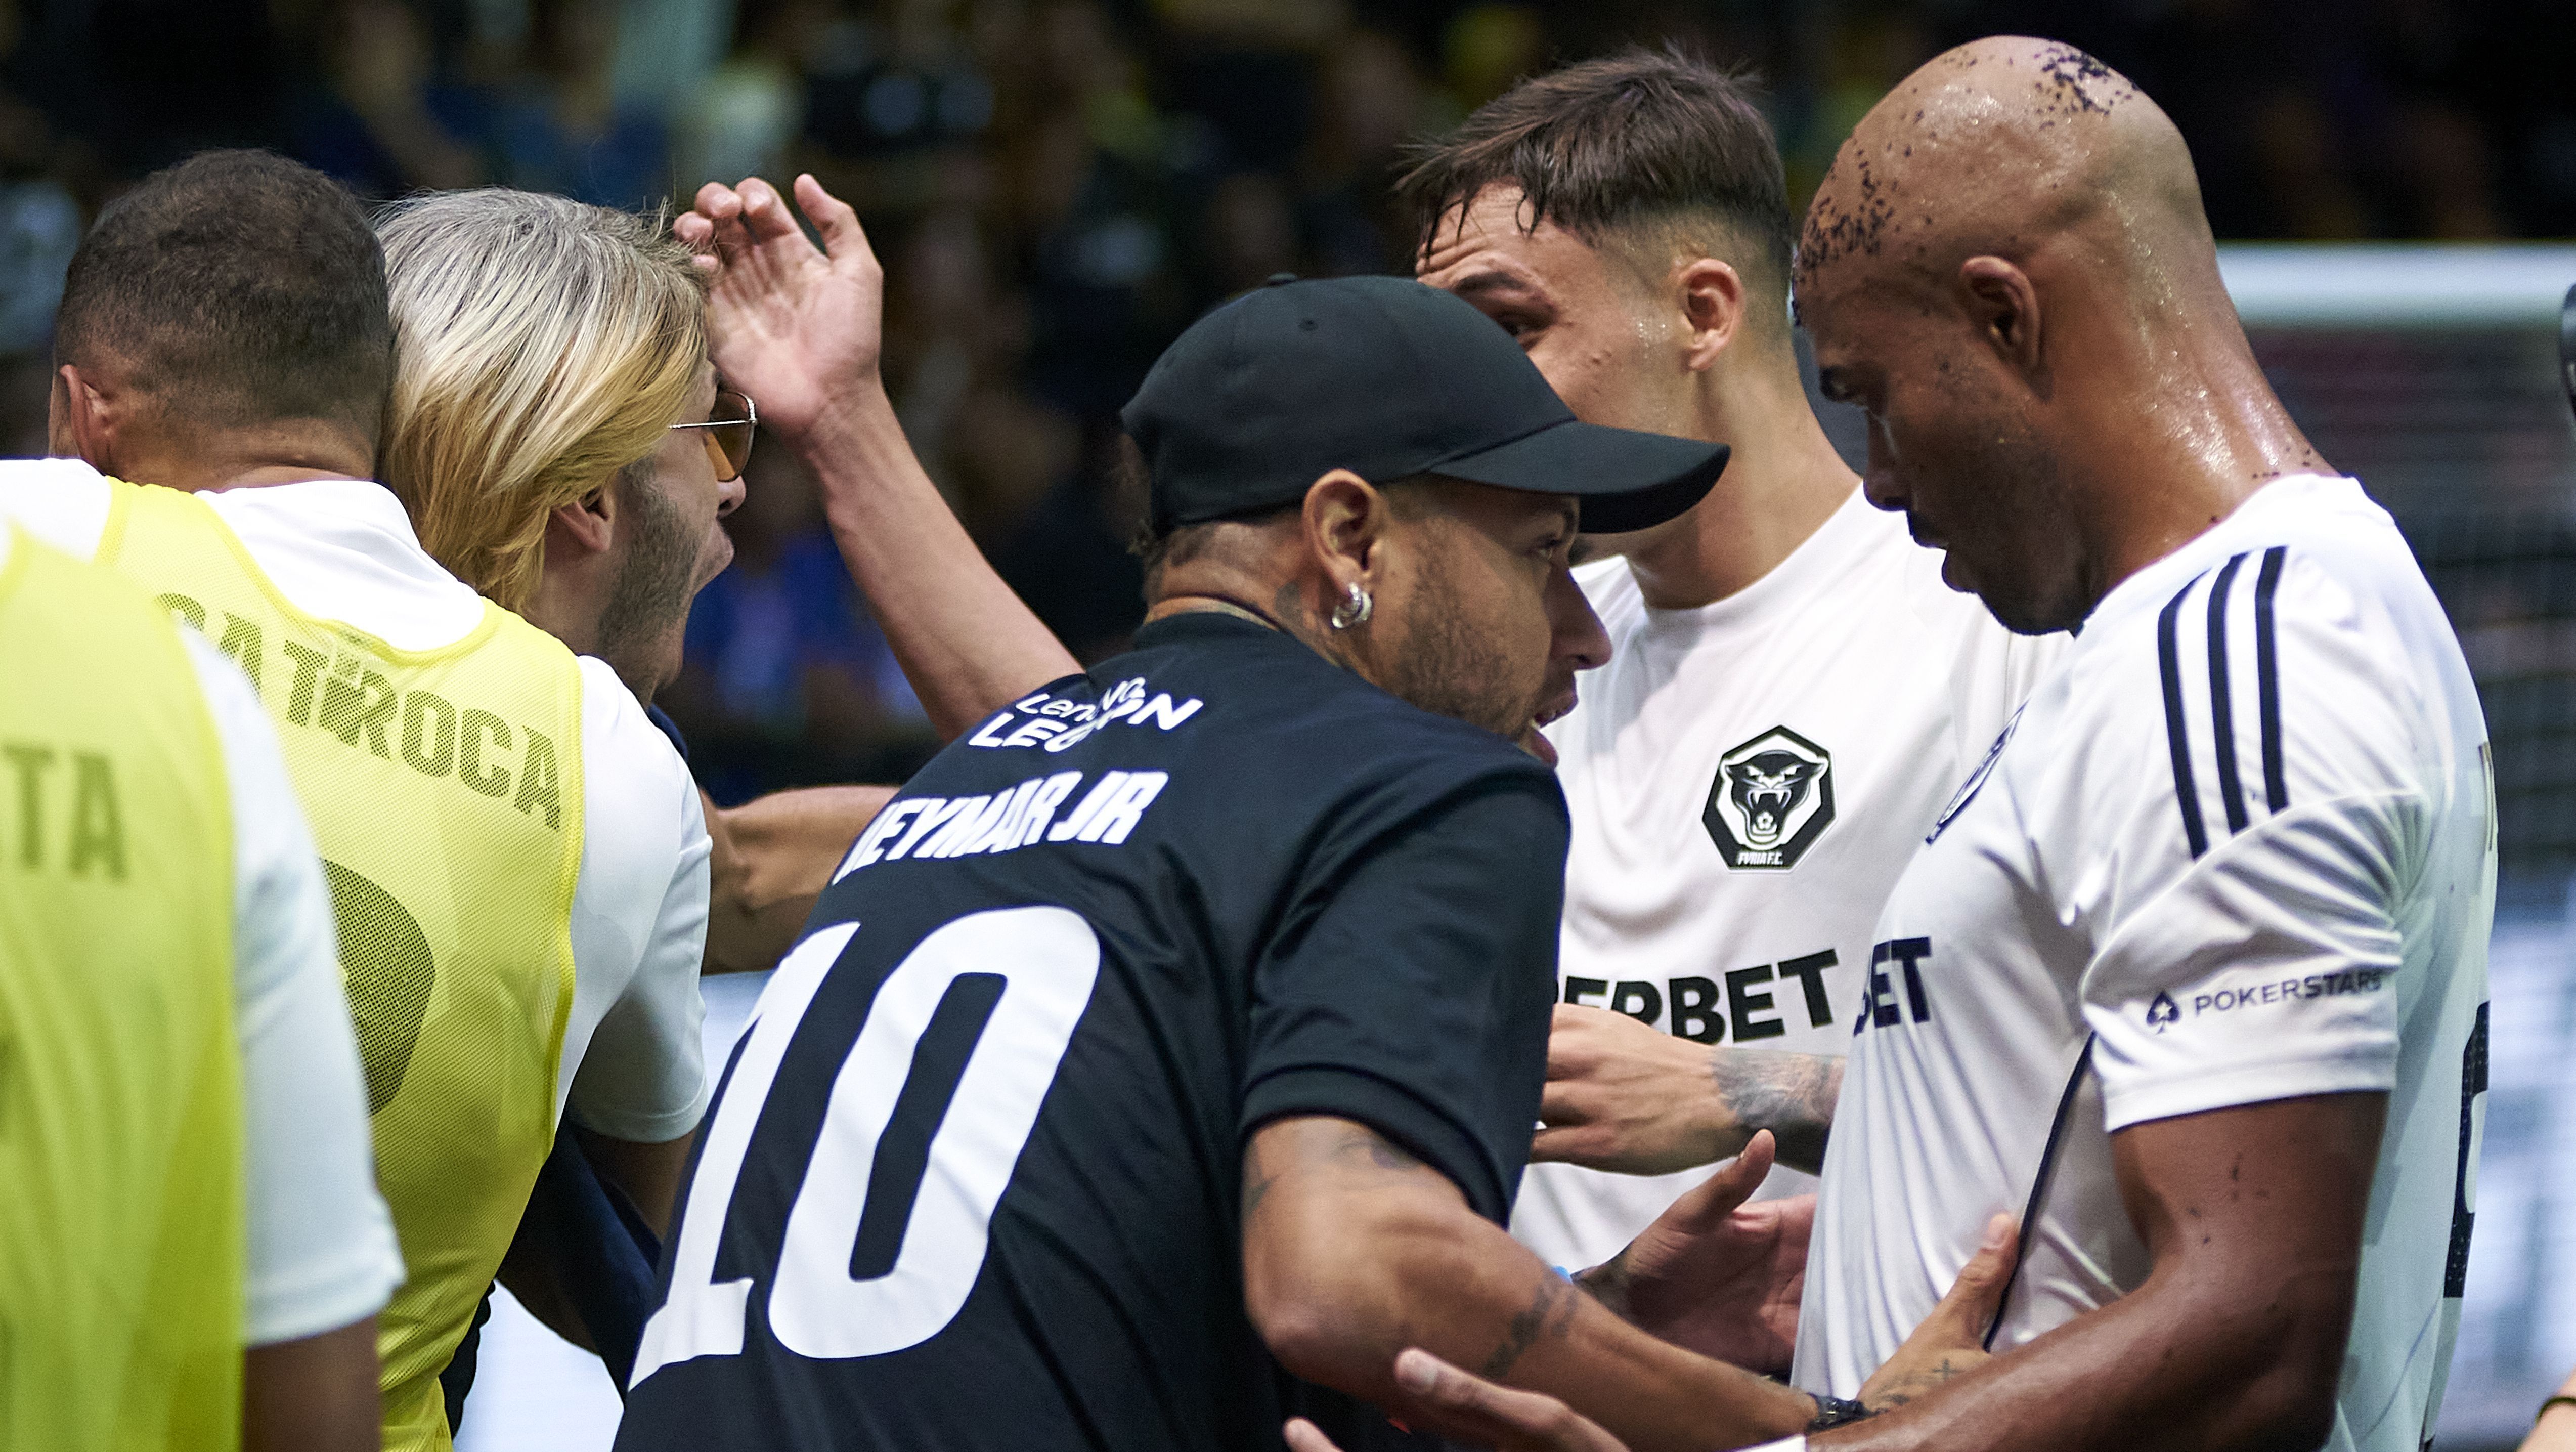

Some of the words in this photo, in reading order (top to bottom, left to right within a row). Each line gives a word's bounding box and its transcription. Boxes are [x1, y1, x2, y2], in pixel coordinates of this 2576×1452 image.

[1047, 770, 1169, 844] JR
[2194, 969, 2383, 1018] POKERSTARS
[628, 905, 1101, 1392] 10
